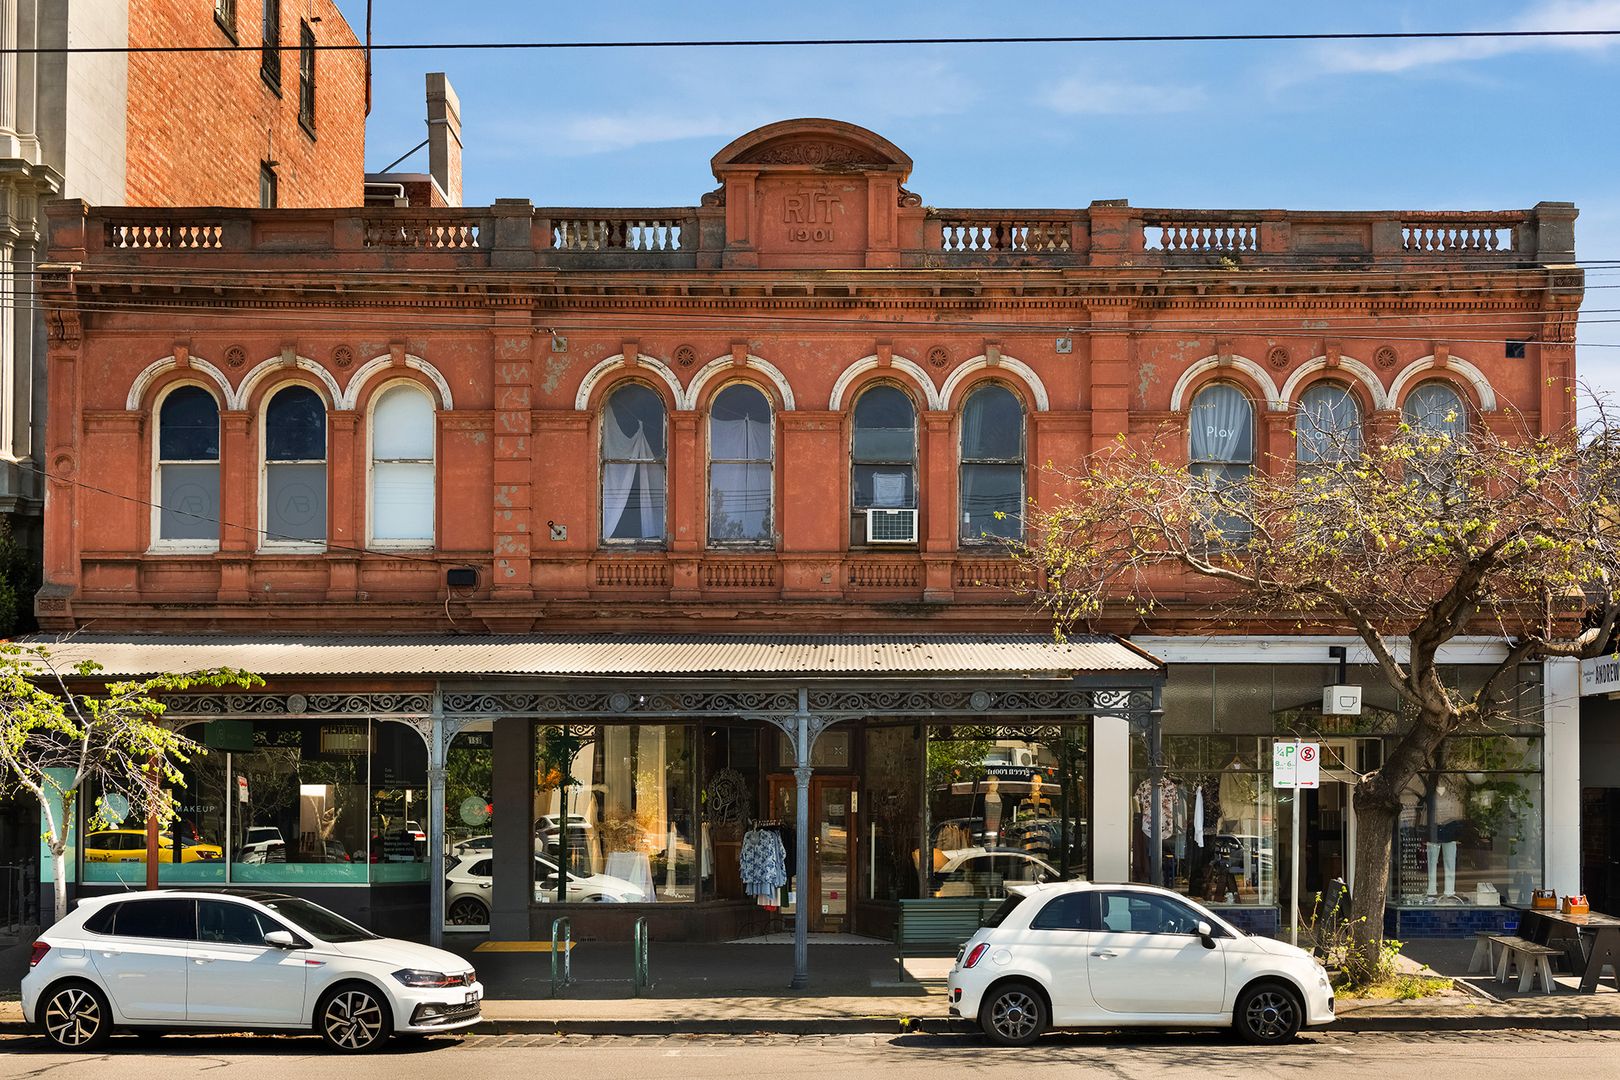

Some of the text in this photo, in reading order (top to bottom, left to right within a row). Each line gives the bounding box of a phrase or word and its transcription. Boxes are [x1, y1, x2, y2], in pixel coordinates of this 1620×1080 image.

[789, 228, 834, 242] 1901
[1207, 425, 1235, 441] Play
[175, 805, 215, 813] MAKEUP
